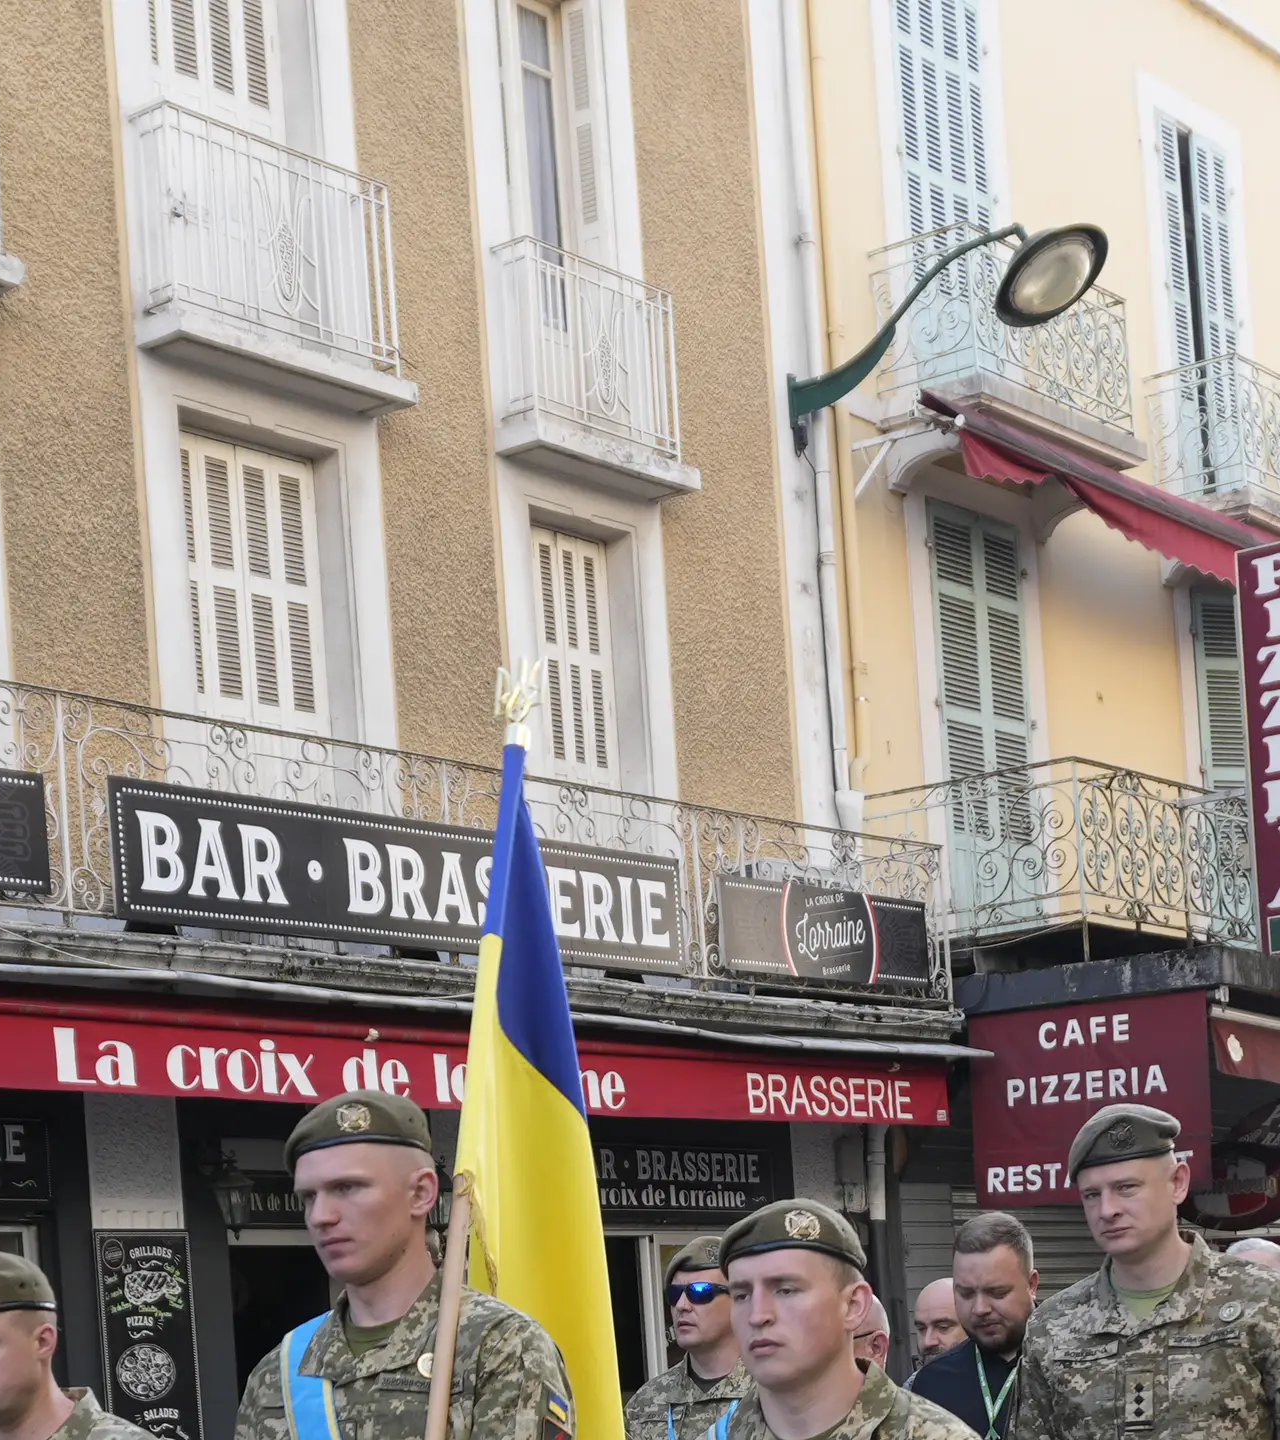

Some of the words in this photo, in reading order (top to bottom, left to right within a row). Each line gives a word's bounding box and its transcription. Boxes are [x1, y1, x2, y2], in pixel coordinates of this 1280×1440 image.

[134, 810, 289, 905] BAR
[805, 898, 813, 908] LA
[814, 894, 835, 906] CROIX
[836, 892, 845, 904] DE
[795, 912, 866, 960] Lorraine
[822, 964, 851, 976] Brasserie
[1038, 1013, 1130, 1050] CAFE
[53, 1026, 137, 1089] La
[165, 1039, 317, 1098] croix
[342, 1048, 410, 1098] de
[746, 1072, 914, 1119] BRASSERIE
[1006, 1064, 1168, 1107] PIZZERIA
[636, 1150, 760, 1184] BRASSERIE
[600, 1182, 637, 1206] roix
[641, 1184, 666, 1207] de
[670, 1184, 747, 1208] Lorraine
[129, 1246, 172, 1260] GRILLADES
[126, 1316, 154, 1328] PIZZAS
[143, 1407, 180, 1421] SALADES
